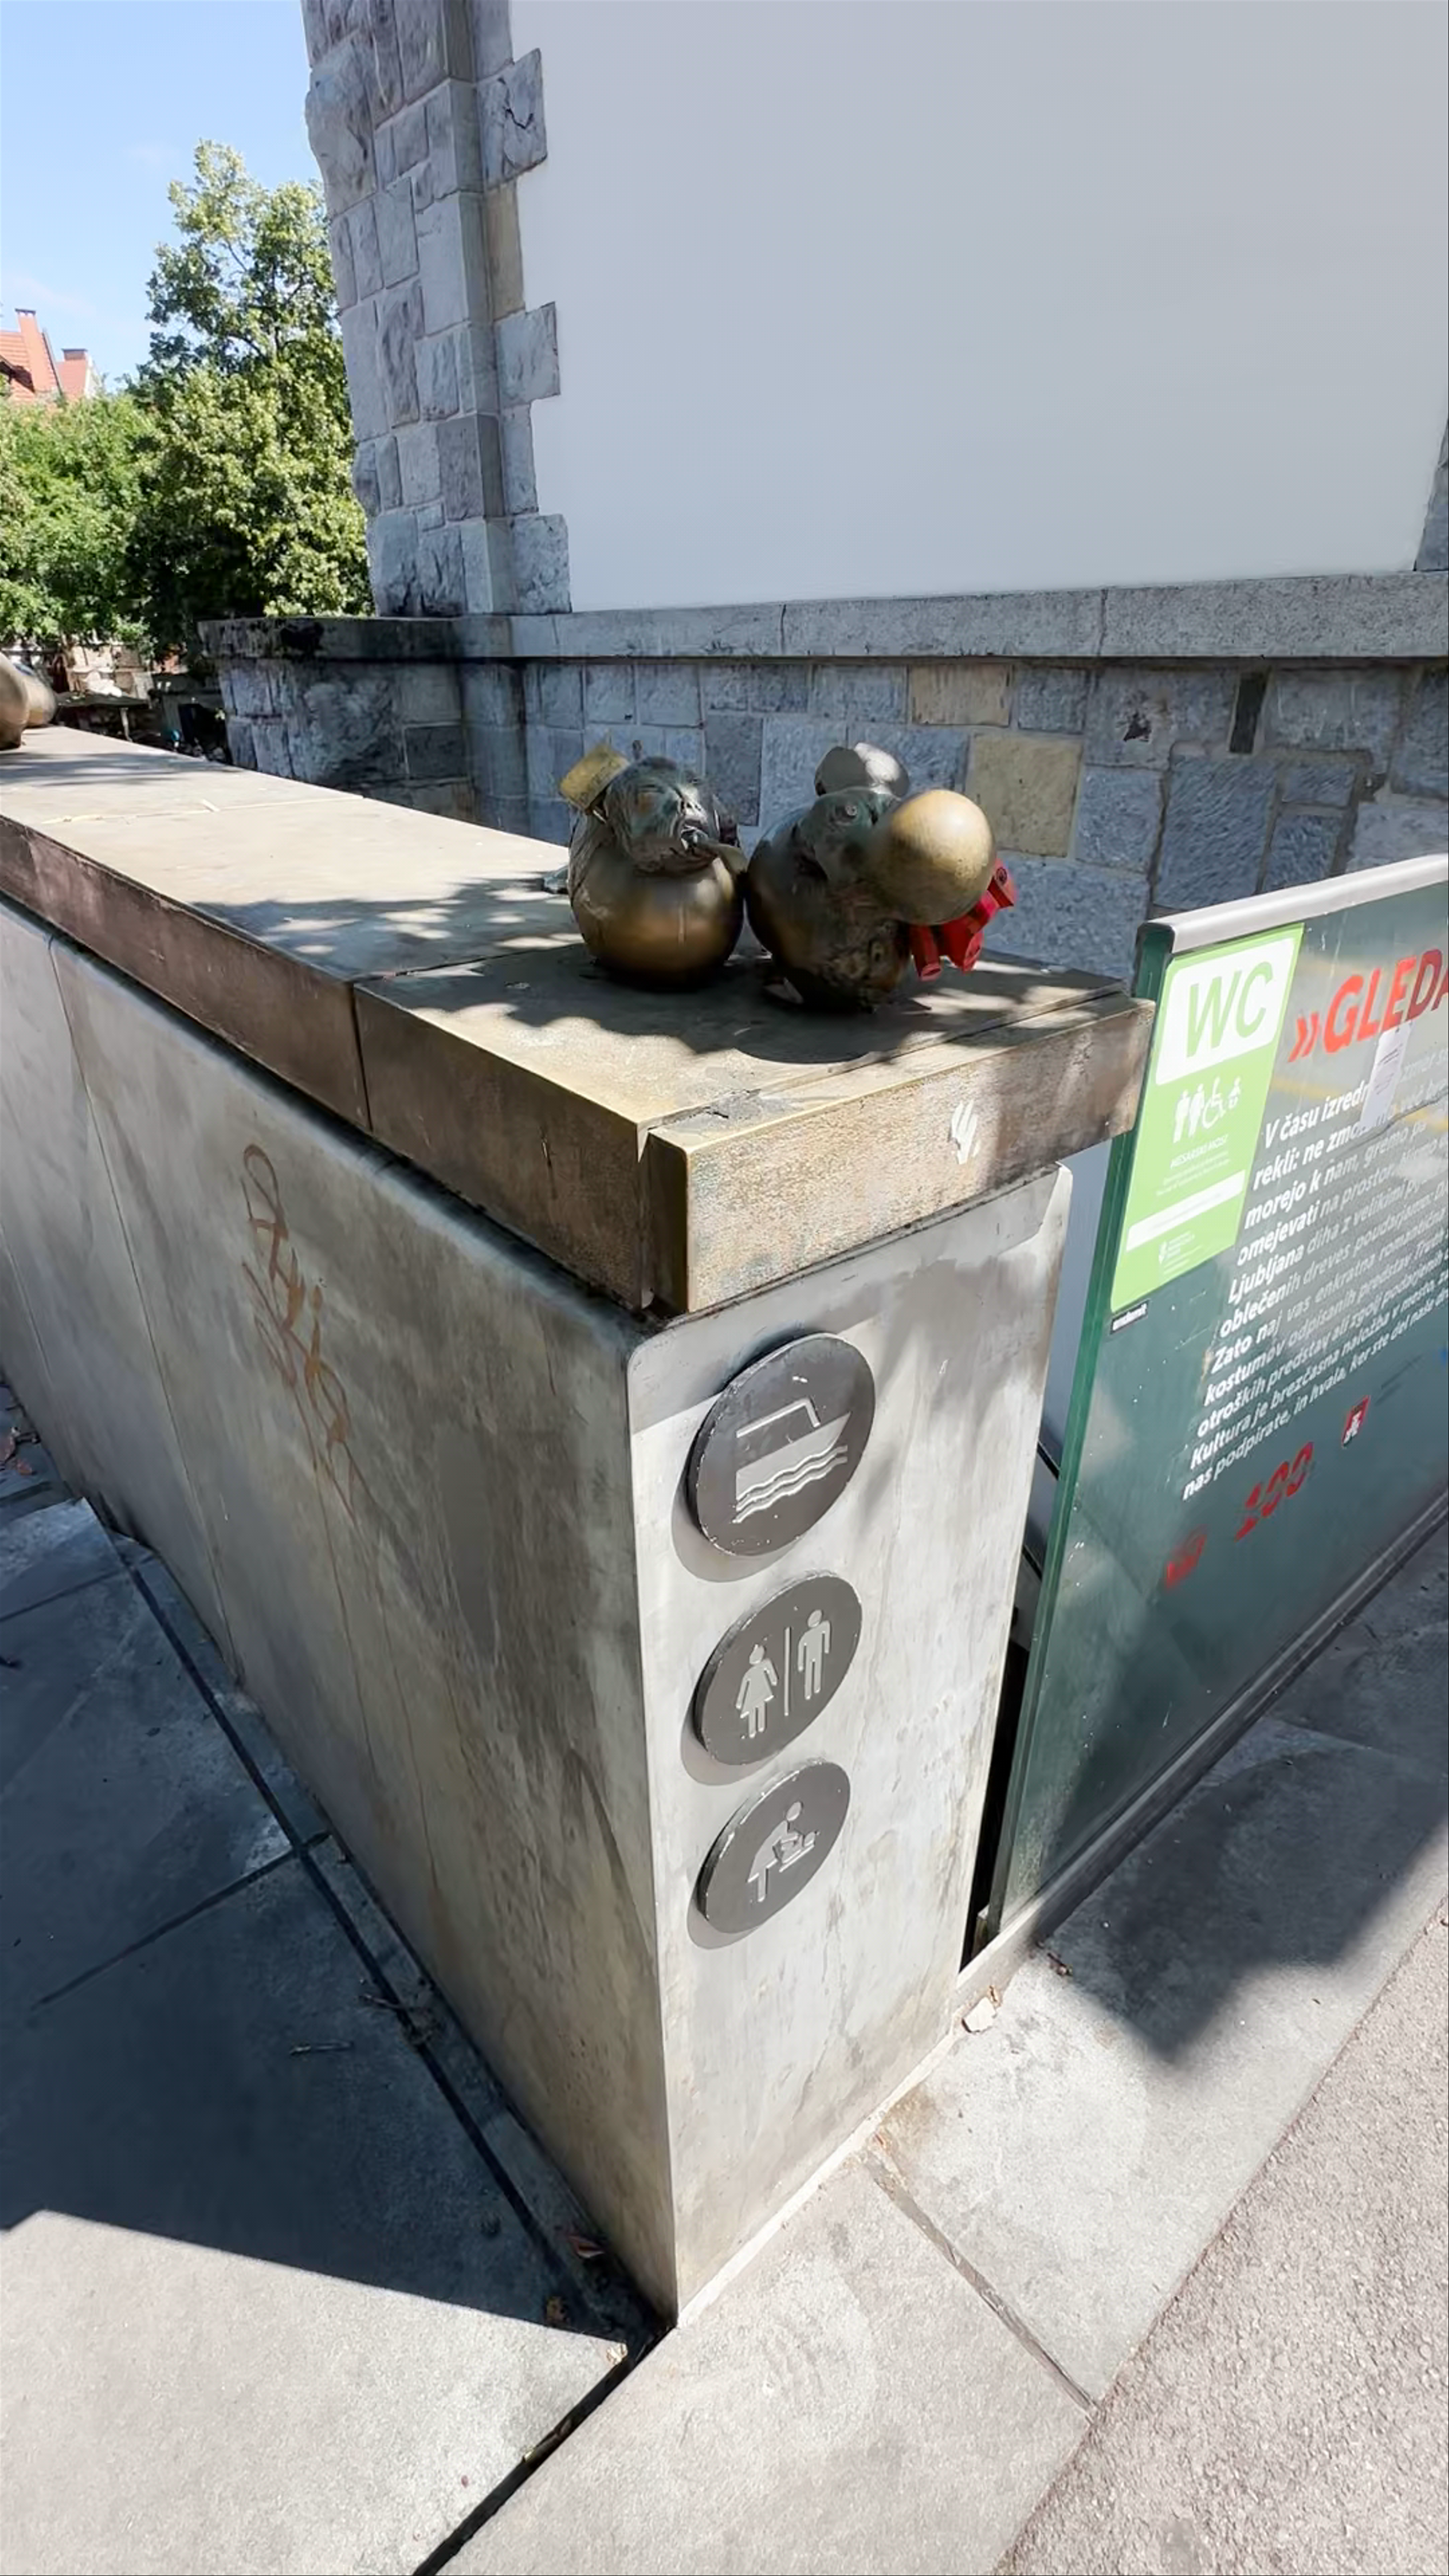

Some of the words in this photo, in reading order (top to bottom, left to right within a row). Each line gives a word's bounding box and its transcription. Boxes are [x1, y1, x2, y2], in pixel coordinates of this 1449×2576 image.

[1186, 961, 1273, 1058] WC
[1253, 1147, 1300, 1190] rekli:
[1302, 1140, 1324, 1165] ne
[1266, 1121, 1280, 1149] V
[1280, 1107, 1320, 1141] času
[1237, 1200, 1320, 1266] omejevati
[1320, 1195, 1340, 1218] na
[1244, 1180, 1306, 1229] morejo
[1309, 1169, 1321, 1193] k
[1323, 1154, 1359, 1186] nam,
[1220, 1272, 1300, 1338] oblečenih
[1303, 1244, 1351, 1284] dreves
[1228, 1244, 1304, 1305] Ljubljana
[1307, 1223, 1340, 1254] diha
[1341, 1216, 1351, 1234] z
[1211, 1335, 1252, 1374] Zato
[1256, 1310, 1282, 1344] naj
[1287, 1296, 1311, 1322] vas
[1315, 1253, 1375, 1303] enkratna
[1190, 1415, 1251, 1470] Kultura
[1251, 1402, 1268, 1429] je
[1270, 1349, 1340, 1409] brezčasna
[1197, 1377, 1266, 1437] otroških
[1331, 1315, 1350, 1341] ali
[1204, 1340, 1285, 1406] kostumov
[1183, 1467, 1212, 1500] nas
[1214, 1410, 1291, 1481] podpirate,
[1294, 1395, 1308, 1415] in
